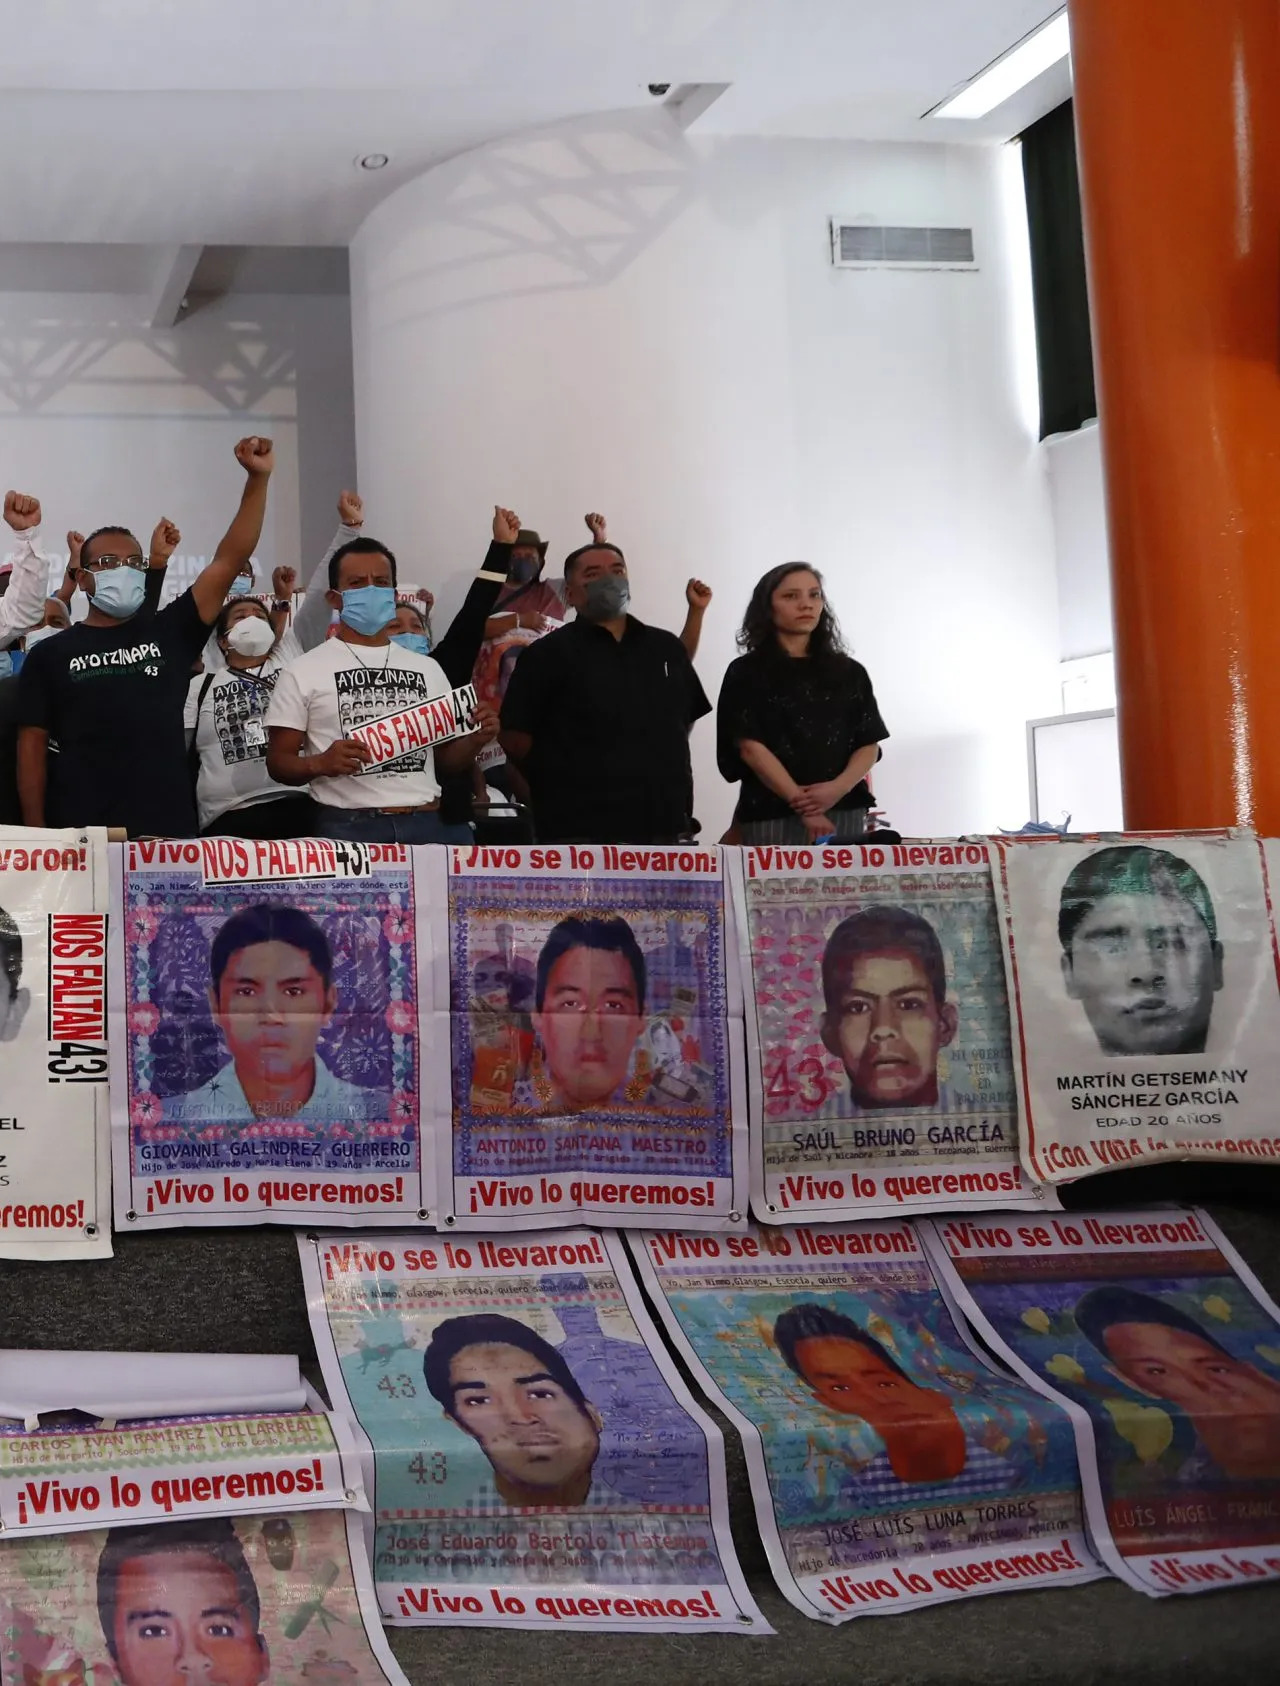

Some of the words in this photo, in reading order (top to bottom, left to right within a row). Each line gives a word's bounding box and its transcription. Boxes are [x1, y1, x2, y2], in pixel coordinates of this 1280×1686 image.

[69, 642, 162, 672] AYOTZINAPA
[144, 666, 159, 677] 43
[336, 669, 426, 690] AYOTZINAPA
[392, 699, 456, 752] FALTAN
[129, 840, 200, 871] ¡Vivo
[202, 839, 249, 879] NOS
[254, 839, 337, 877] FALTAN
[530, 848, 562, 869] se
[569, 846, 595, 870] lo
[748, 846, 814, 878] ¡Vivo
[822, 848, 853, 869] se
[860, 845, 885, 868] lo
[52, 914, 105, 959] NOS
[52, 964, 105, 1041] FALTAN
[48, 1041, 109, 1084] 43!
[1057, 1071, 1126, 1090] MARTÍN
[1131, 1069, 1249, 1087] GETSEMANY
[1071, 1092, 1161, 1110] SÁNCHEZ
[1166, 1090, 1239, 1106] GARCÍA
[792, 1127, 842, 1151] SAÚL
[854, 1127, 916, 1148] BRUNO
[926, 1120, 1004, 1144] GARCÍA
[1097, 1117, 1142, 1128] EDAD
[1148, 1115, 1168, 1126] 20
[1176, 1112, 1222, 1125] AÑOS
[141, 1144, 221, 1159] GIOVANNI
[230, 1141, 322, 1156] GALINDREZ
[331, 1141, 411, 1156] GUERRERO
[476, 1137, 547, 1155] ANTONIO
[554, 1134, 622, 1151] SANTANA
[631, 1136, 707, 1155] MAESTRO
[141, 1162, 162, 1173] Hijo
[375, 1159, 411, 1169] Arcelia
[146, 1179, 214, 1213] ¡Vivo
[224, 1177, 249, 1201] lo
[257, 1177, 404, 1207] queremos!
[470, 1180, 534, 1213] ¡Vivo
[540, 1178, 563, 1204] lo
[570, 1181, 715, 1208] queremos!
[779, 1175, 844, 1209] ¡Vivo
[852, 1173, 877, 1199] lo
[883, 1165, 1023, 1203] queremos!
[649, 1231, 720, 1267] ¡Vivo
[726, 1236, 759, 1257] se
[795, 1225, 918, 1257] llevaron!
[943, 1221, 1014, 1257] ¡Vivo
[1018, 1225, 1053, 1248] se
[1051, 1219, 1085, 1246] lo
[1082, 1215, 1206, 1246] llevaron!
[404, 1249, 438, 1271] se
[443, 1242, 473, 1270] lo
[478, 1236, 605, 1269] llevaron!
[406, 1285, 449, 1299] Glasgow,
[497, 1283, 530, 1296] quiero
[775, 1275, 815, 1287] Escocia,
[818, 1275, 848, 1286] quiero
[8, 1437, 72, 1453] CARLOS
[215, 1420, 318, 1439] VILLARREAL
[17, 1480, 101, 1525] ¡Vivo
[110, 1476, 142, 1509] lo
[151, 1459, 325, 1513] queremos!
[823, 1521, 863, 1548] JOSÉ
[871, 1515, 915, 1539] LUÍS
[925, 1509, 967, 1532] LUNA
[975, 1501, 1039, 1524] TORRES
[440, 1533, 519, 1551] Eduardo
[528, 1531, 608, 1552] Bartolo
[618, 1531, 708, 1551] Tlatempa
[818, 1574, 900, 1612] ¡Vivo
[892, 1566, 933, 1595] lo
[932, 1539, 1086, 1594] queremos!
[397, 1588, 484, 1617] ¡Vivo
[489, 1588, 528, 1616] lo
[535, 1590, 723, 1621] queremos!
